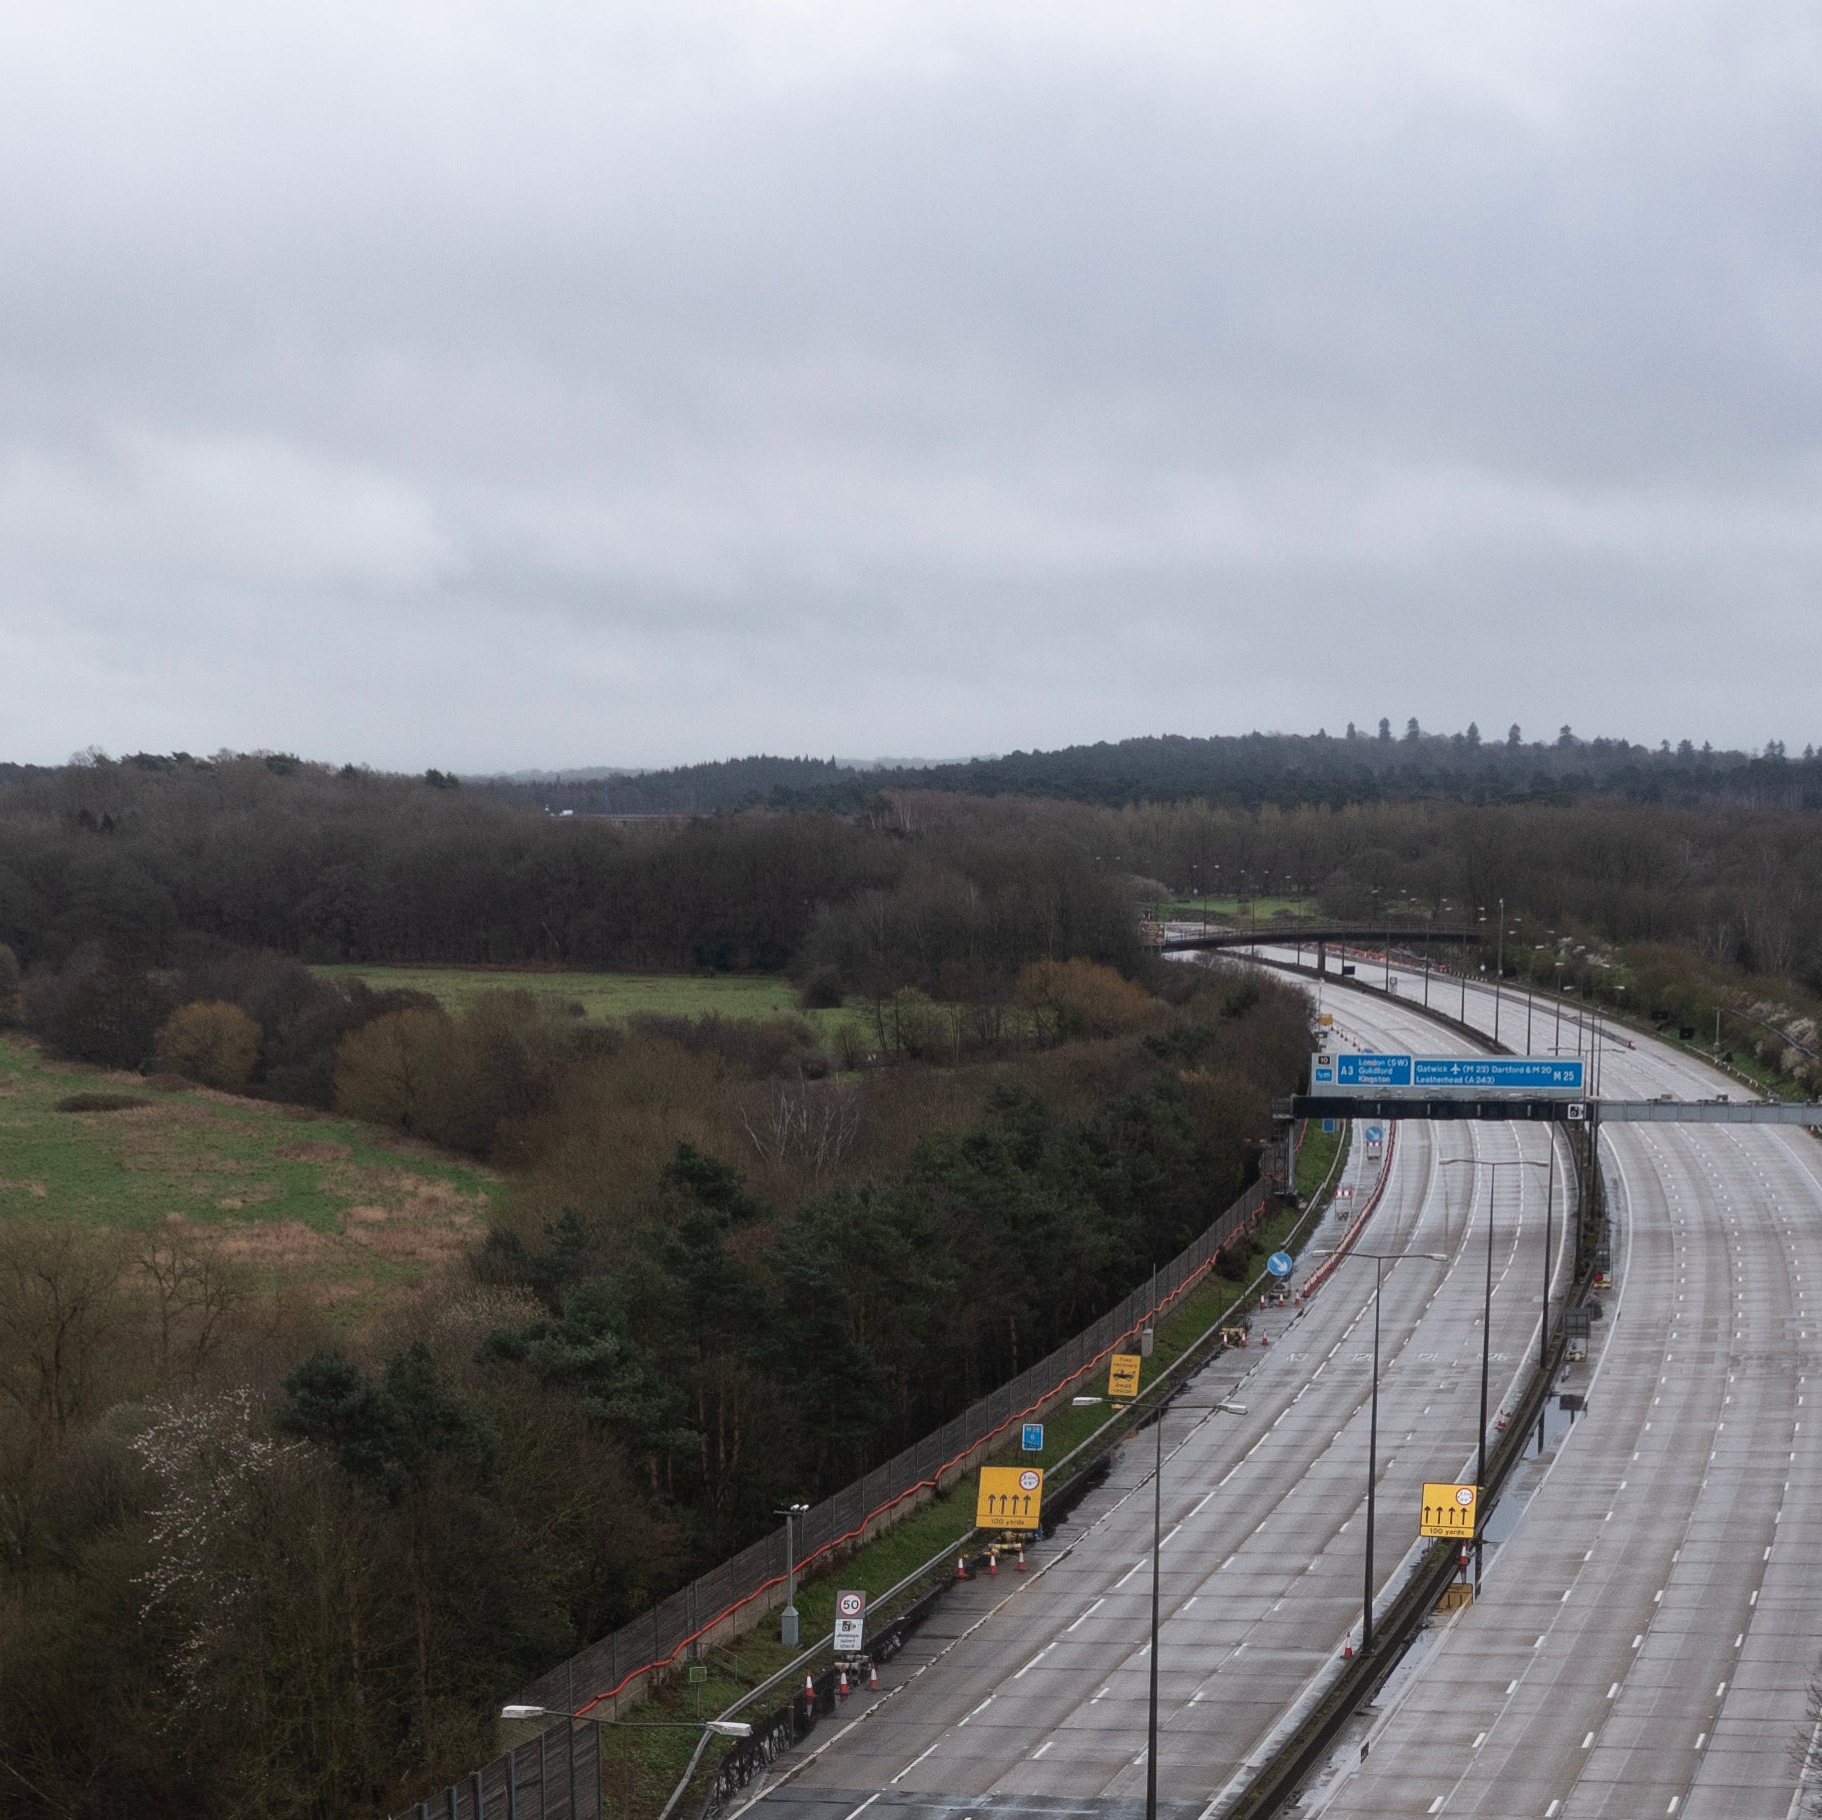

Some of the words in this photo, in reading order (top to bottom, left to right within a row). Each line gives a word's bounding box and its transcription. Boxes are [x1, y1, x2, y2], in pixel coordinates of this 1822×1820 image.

[1358, 1058, 1386, 1066] London
[1358, 1067, 1393, 1075] Guildford
[1417, 1064, 1448, 1073] Gatwick
[1491, 1066, 1525, 1074] Dartford
[1358, 1075, 1391, 1084] Kingston
[1415, 1076, 1463, 1084] Leatherhead
[1445, 1528, 1465, 1536] yards
[843, 1600, 859, 1609] 50
